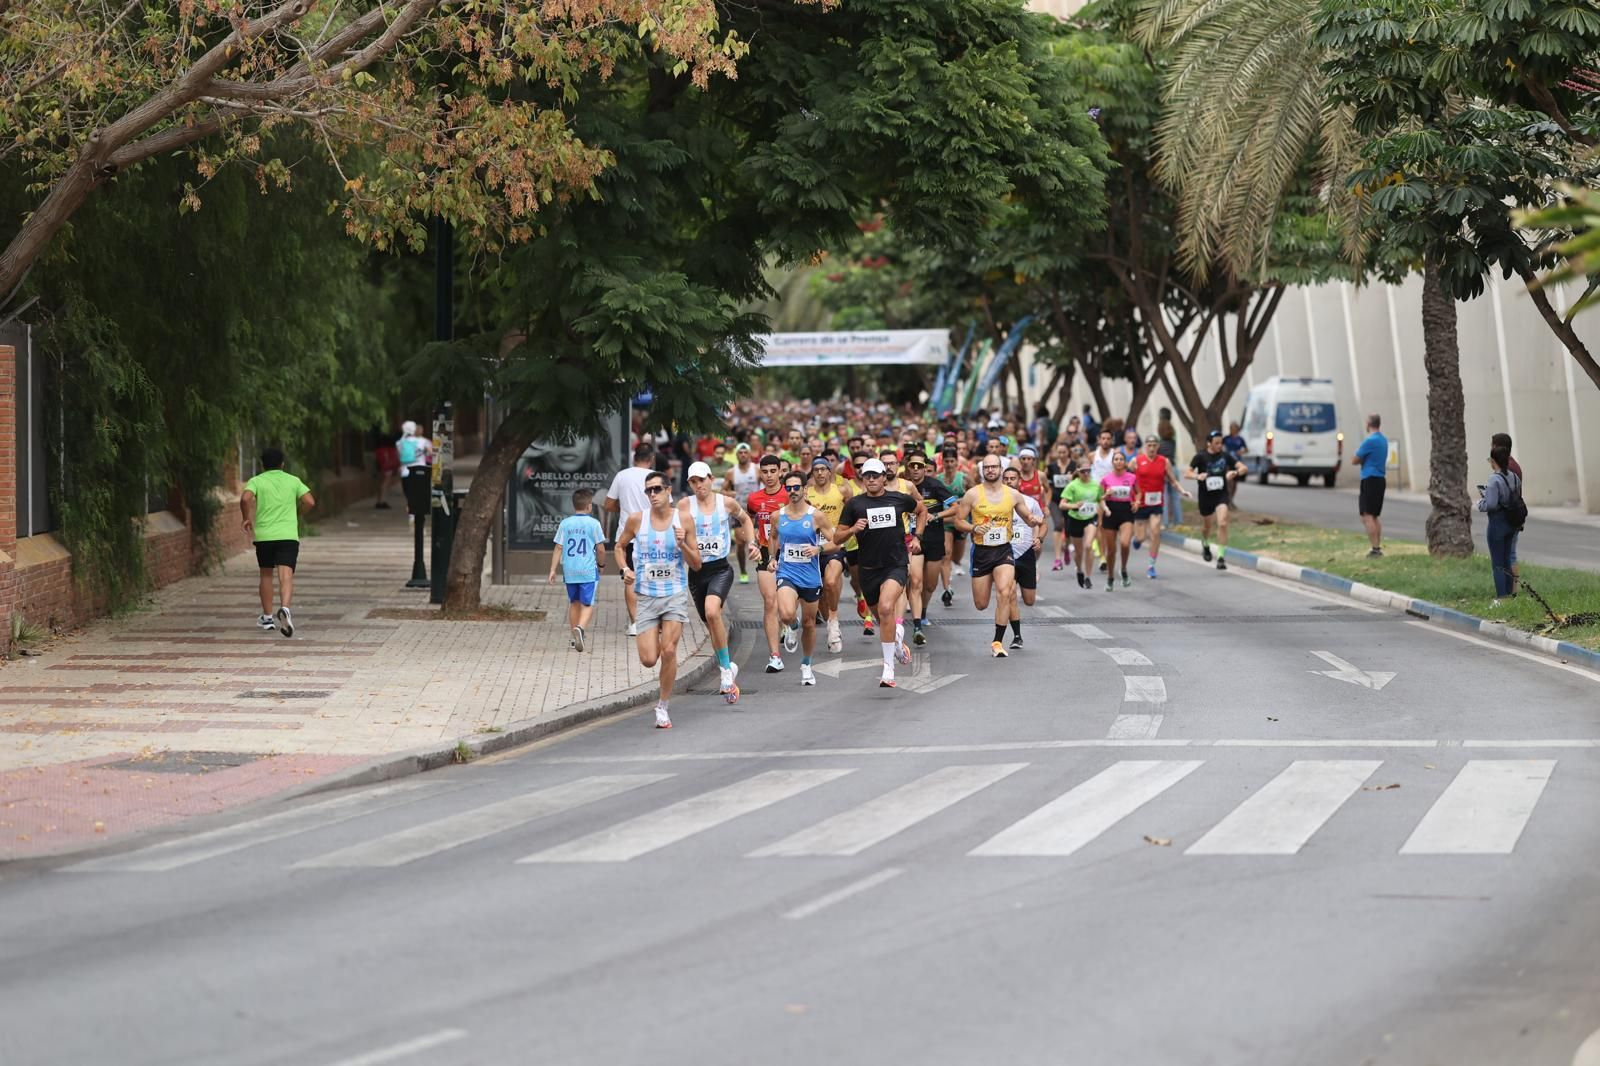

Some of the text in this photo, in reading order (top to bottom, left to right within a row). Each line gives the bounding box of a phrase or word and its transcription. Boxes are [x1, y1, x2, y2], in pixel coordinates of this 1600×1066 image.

[528, 472, 609, 480] CABELLO GLOSSY
[541, 514, 564, 523] GLO
[872, 514, 892, 522] 859
[533, 523, 560, 532] ABSO
[567, 538, 587, 557] 24
[698, 542, 718, 550] 344
